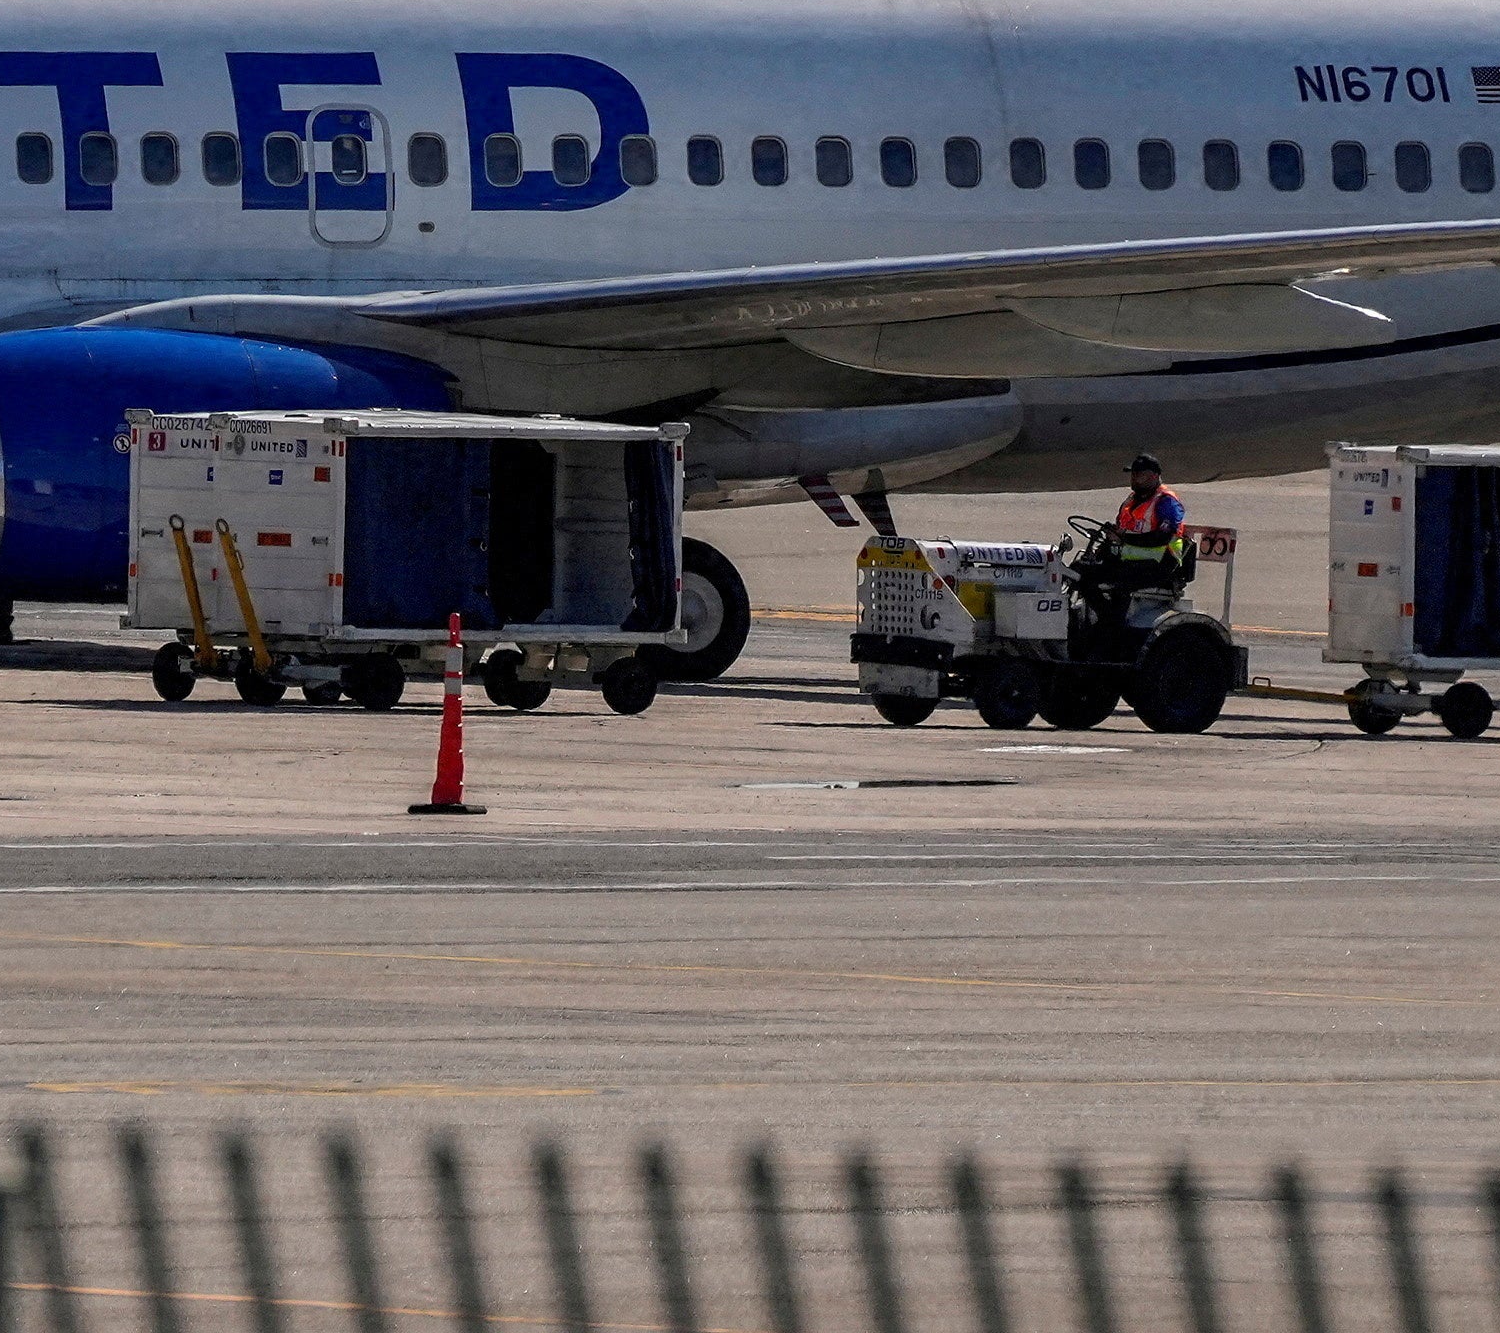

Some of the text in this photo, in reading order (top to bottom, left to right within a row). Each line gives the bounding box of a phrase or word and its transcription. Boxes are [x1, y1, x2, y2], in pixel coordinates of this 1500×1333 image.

[1294, 65, 1450, 103] N16701
[251, 440, 293, 453] UNITED
[965, 547, 1024, 561] UNITED
